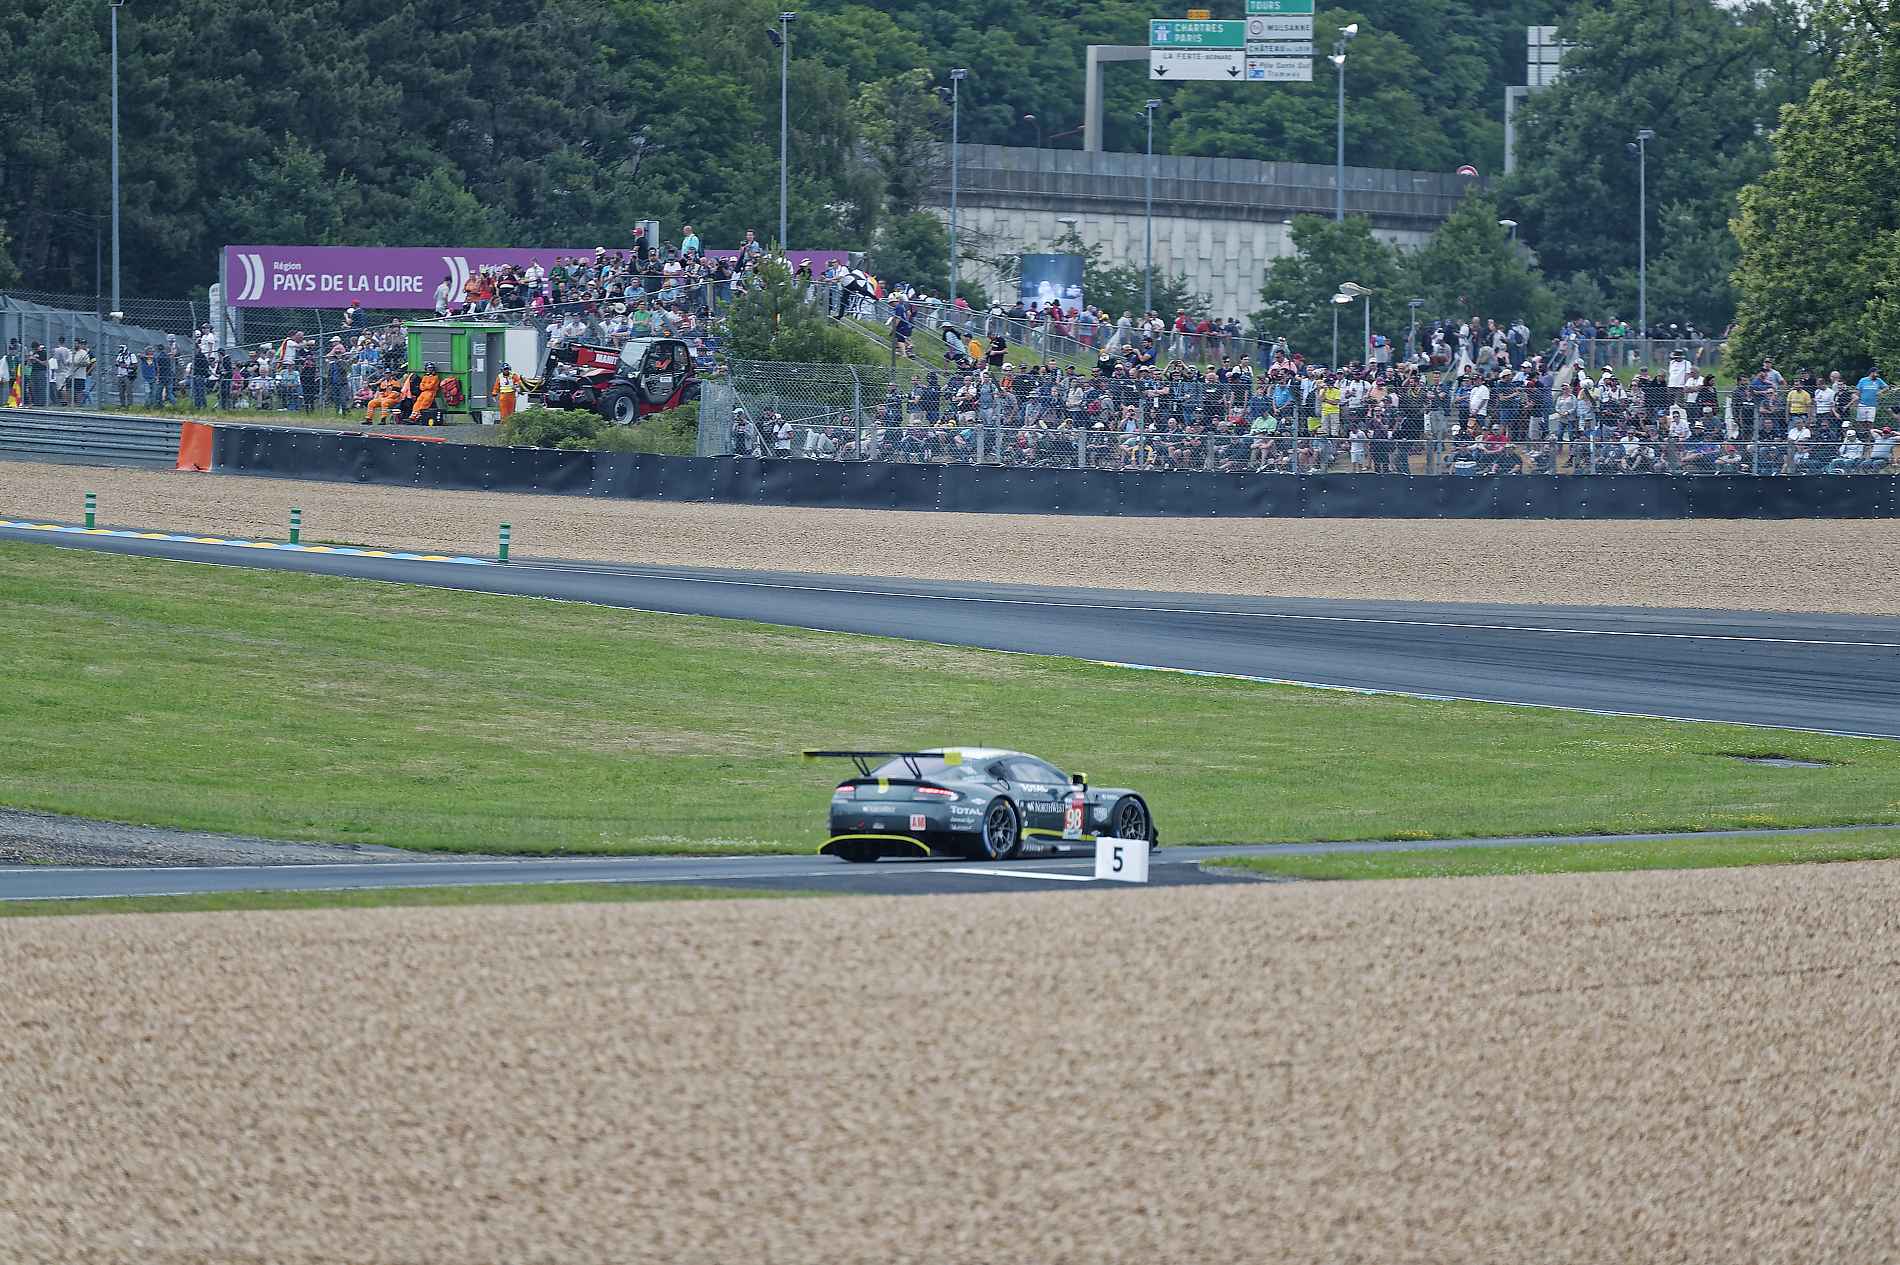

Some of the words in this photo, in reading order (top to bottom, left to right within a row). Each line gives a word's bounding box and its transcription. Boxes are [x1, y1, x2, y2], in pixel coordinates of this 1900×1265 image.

[1250, 1, 1280, 10] TOURS
[1175, 24, 1224, 33] CHARTRES
[1174, 34, 1202, 42] PARIS
[273, 262, 301, 272] Région
[273, 275, 316, 291] PAYS
[320, 276, 343, 291] DE
[347, 277, 371, 292] LA
[374, 277, 424, 293] LOIRE
[950, 805, 984, 816] TOTAL
[1066, 808, 1082, 829] 98
[1112, 847, 1124, 872] 5
